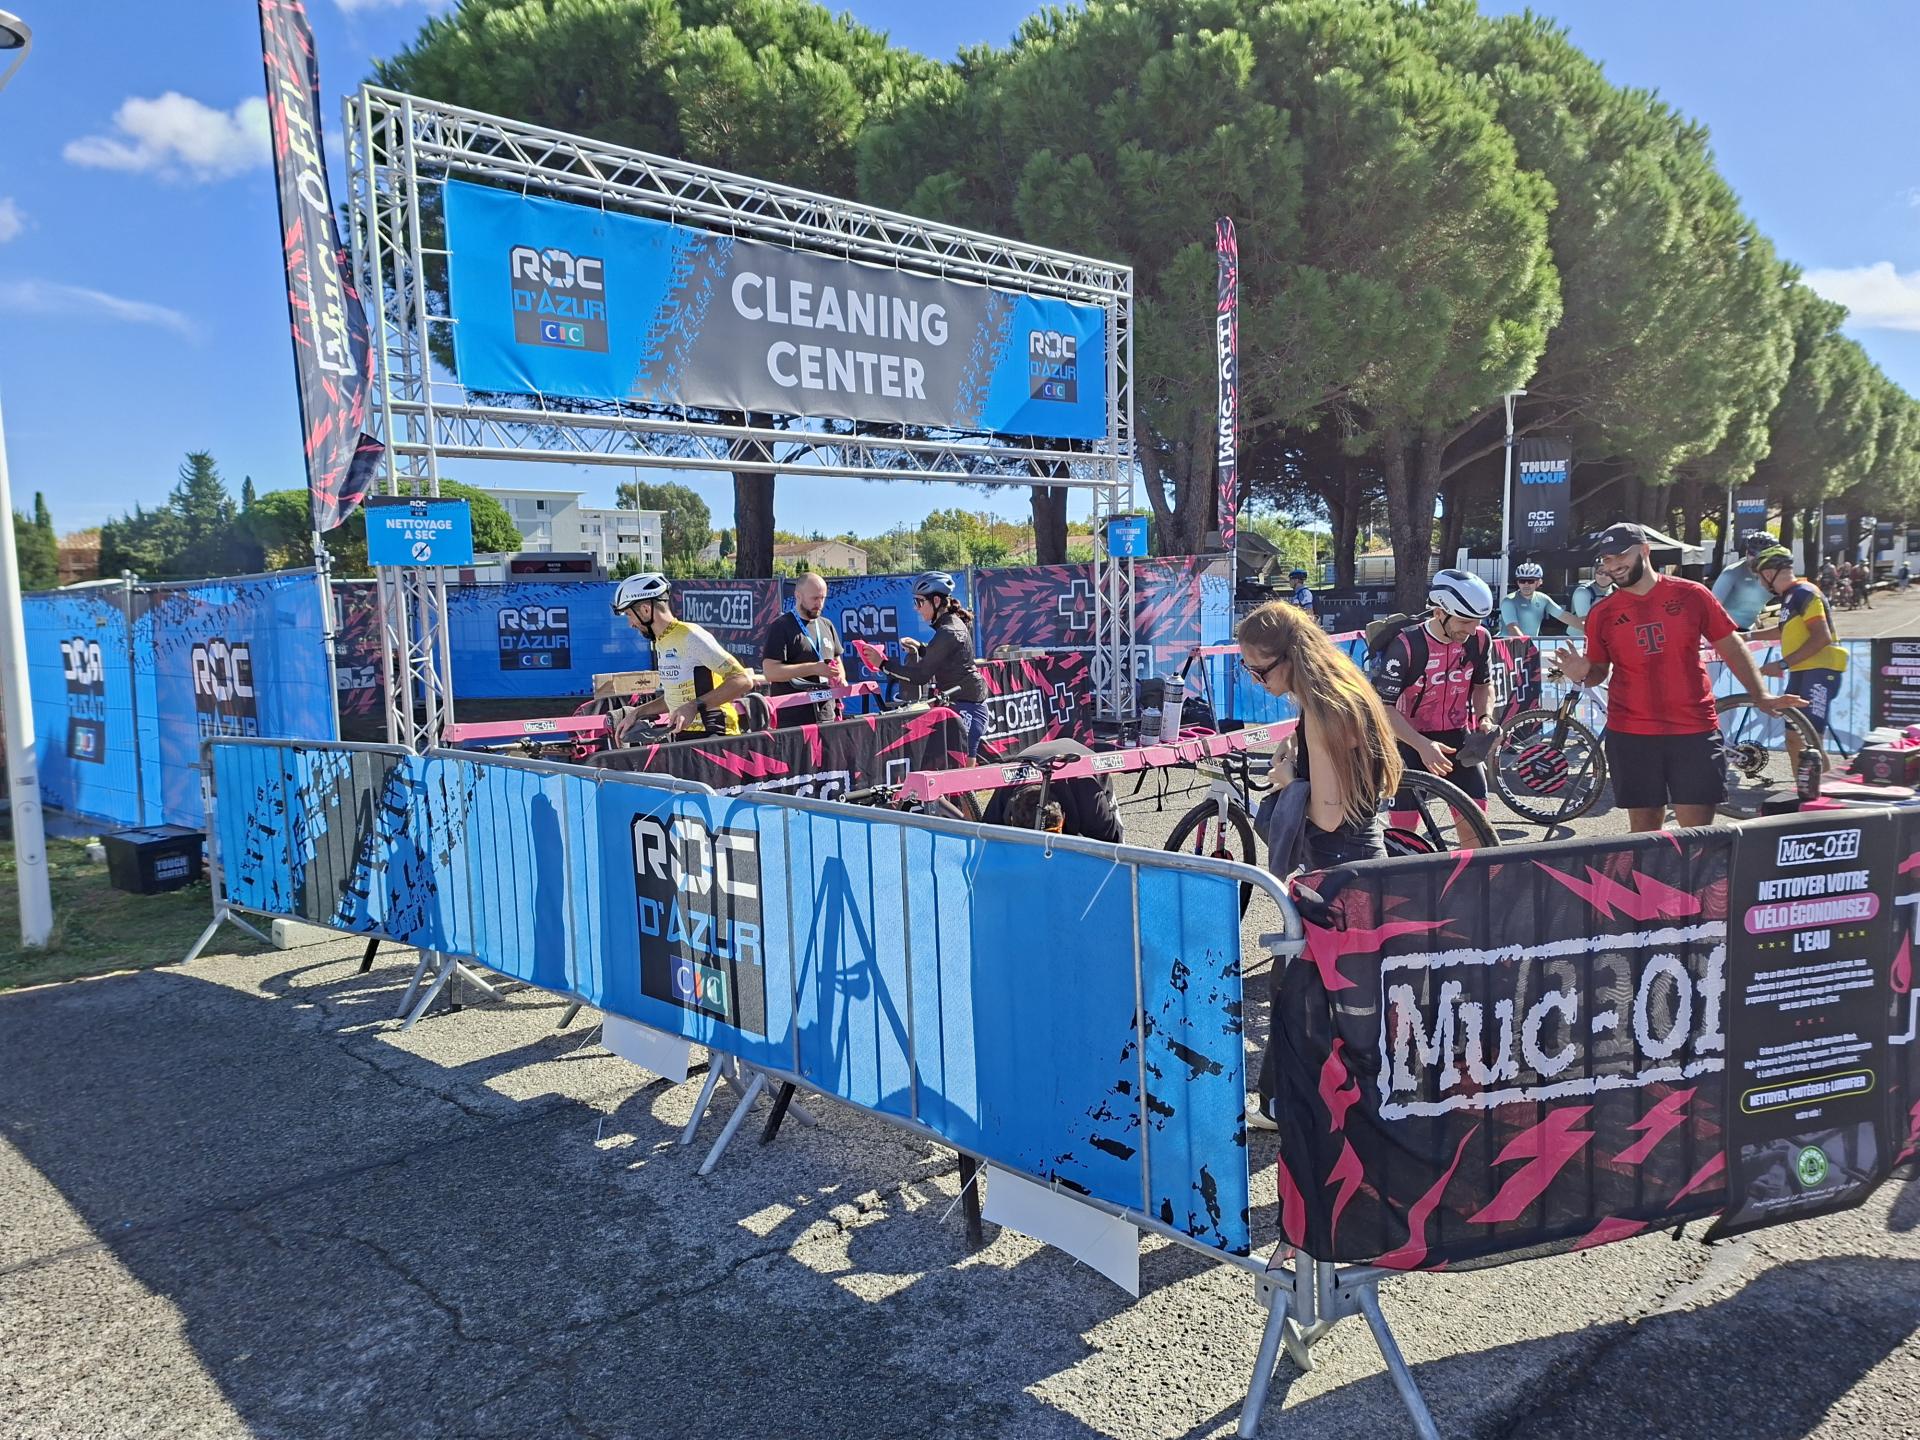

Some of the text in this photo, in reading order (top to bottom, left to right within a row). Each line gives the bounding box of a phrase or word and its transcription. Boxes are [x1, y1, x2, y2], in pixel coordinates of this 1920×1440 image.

[512, 248, 602, 290] ROC
[513, 288, 606, 321] D'AZUR
[731, 271, 948, 346] CLEANING
[545, 324, 580, 342] CIC
[1030, 331, 1076, 358] ROC
[766, 340, 927, 400] CENTER
[1030, 359, 1076, 380] D'AZUR
[1045, 384, 1063, 397] CIC
[1520, 461, 1566, 473] THULE
[1520, 472, 1567, 485] WOUF
[1528, 511, 1555, 520] ROC
[1737, 499, 1766, 507] THULE
[386, 519, 453, 530] NETTOYAGE
[404, 531, 437, 540] A SEC
[500, 607, 567, 630] ROC
[685, 596, 749, 623] Muc-Off
[841, 606, 897, 634] ROC
[500, 633, 568, 650] D'AZUR
[192, 641, 254, 701] ROC
[1003, 766, 1038, 780] Muc-Off
[1093, 756, 1123, 769] Muc-Off
[635, 819, 757, 898] ROC
[1781, 833, 1857, 861] Muc-Off
[1758, 869, 1870, 901] NETTOYER VOTRE
[1754, 897, 1871, 930] VÉLO ÉCONOMISEZ
[639, 894, 761, 966] D'AZUR
[1794, 929, 1831, 953] L'EAU
[675, 965, 721, 1005] CIC
[1388, 941, 1727, 1092] Muc-Of
